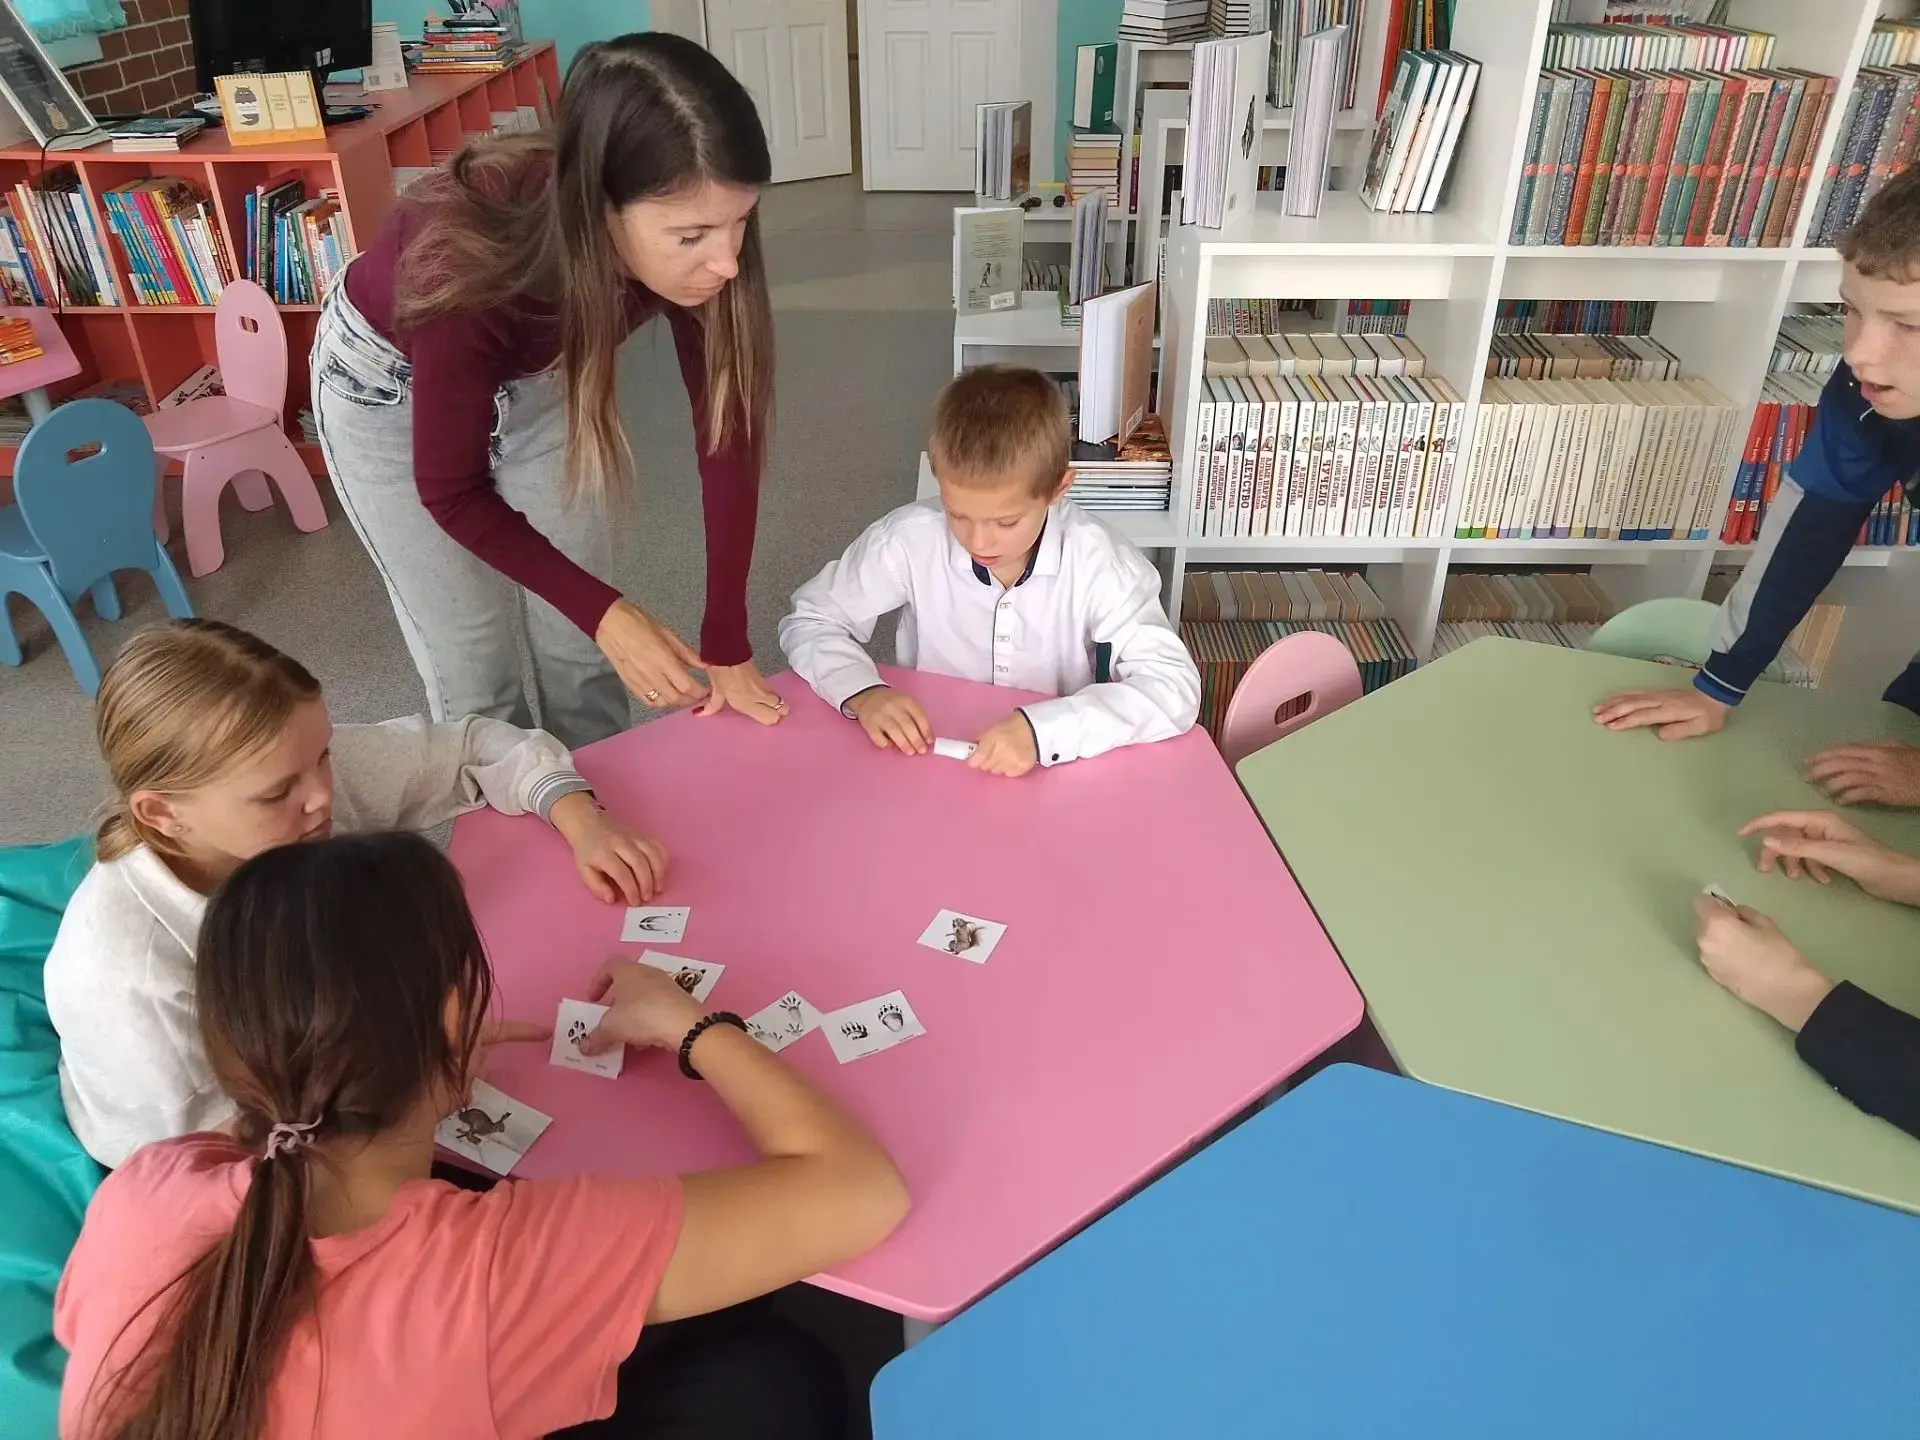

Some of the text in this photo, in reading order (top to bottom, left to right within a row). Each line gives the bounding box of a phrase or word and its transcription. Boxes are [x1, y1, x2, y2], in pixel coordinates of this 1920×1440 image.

[1209, 456, 1219, 510] ПРИКЛЮЧЕНИЙ
[1217, 465, 1225, 501] МИЛЛИОН
[1241, 459, 1254, 509] ДЕТСТВО
[1260, 457, 1272, 509] АЛЫЕ ПАРУСА
[1278, 455, 1287, 488] РОБИНЗОН
[1290, 460, 1300, 506] КАРА-БУМБЫ
[1297, 472, 1306, 499] ДЕБРЯХ
[1318, 460, 1331, 506] ЧУЧЕЛО
[1362, 455, 1377, 509] СЫН ПОЛКА
[1378, 454, 1394, 509] БЕЛЫЙ ПУДЕЛЬ
[1393, 458, 1408, 509] ПОЛЛИАННА
[1510, 475, 1520, 497] КОЗЕТТА
[1520, 474, 1528, 497] КОЗЕТТА
